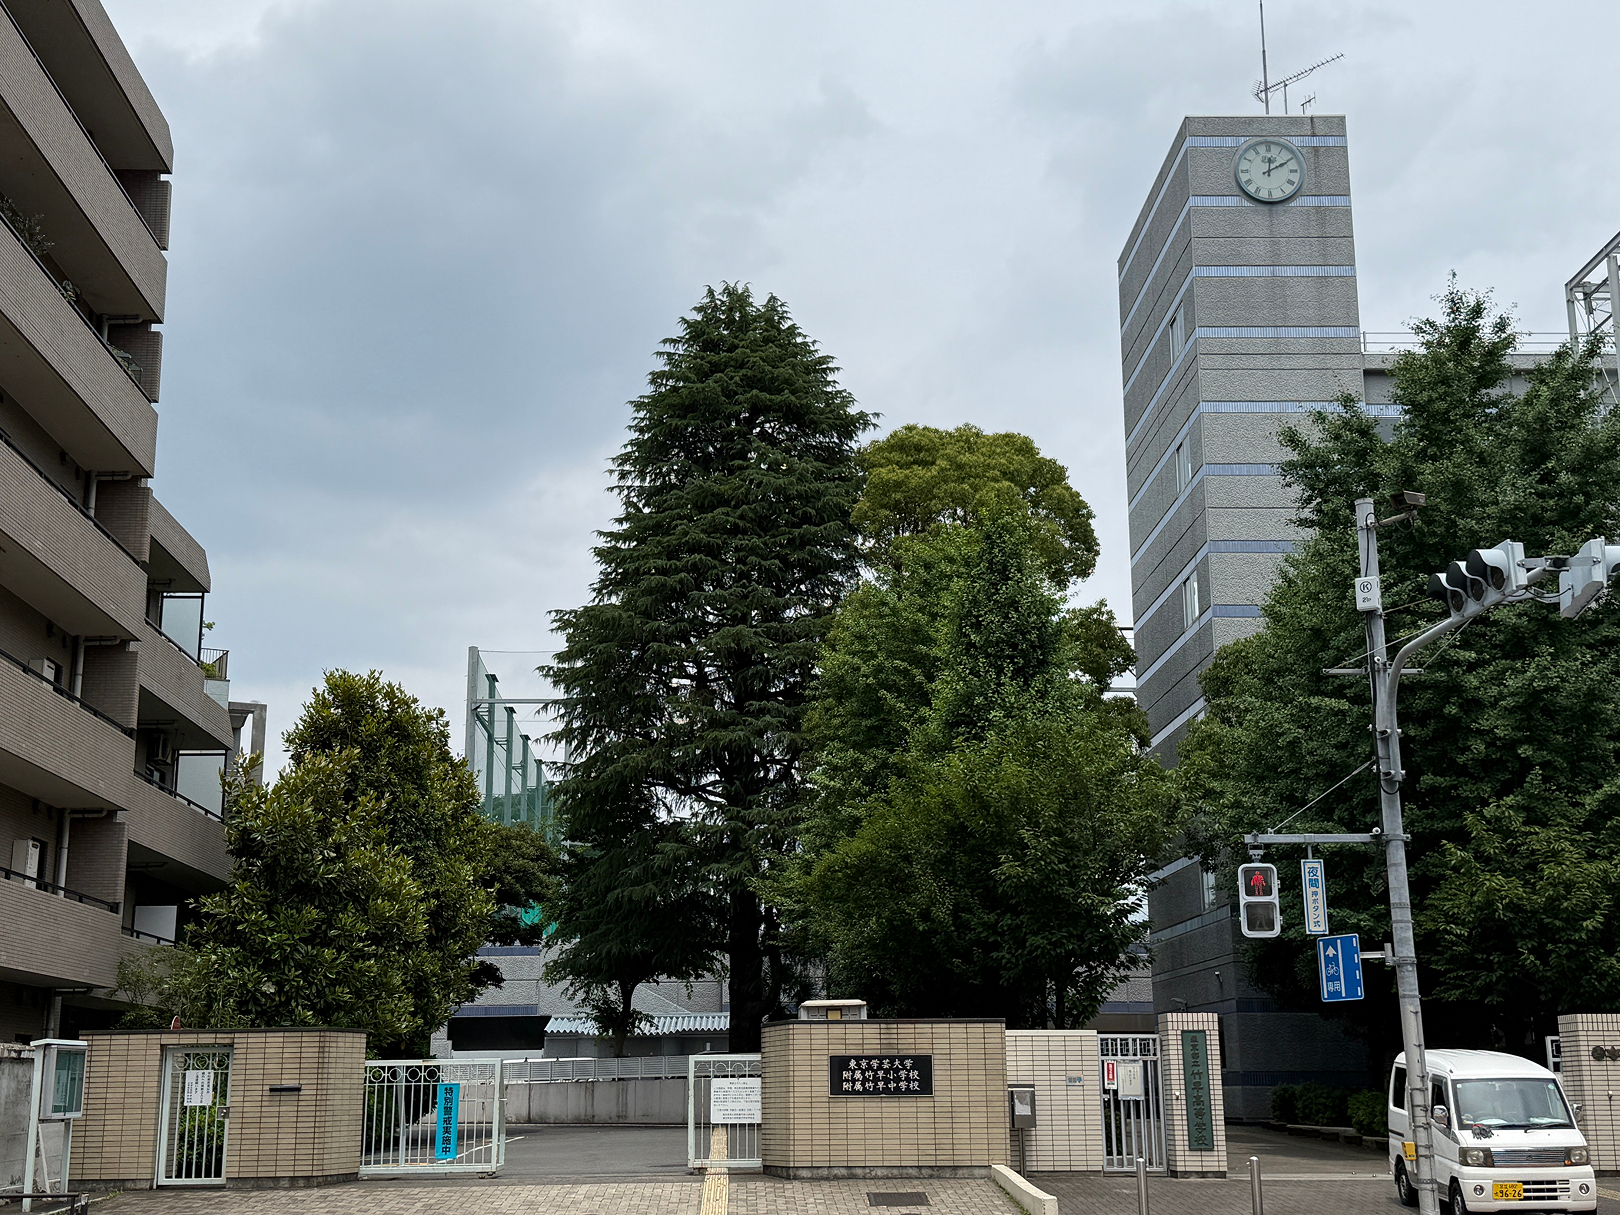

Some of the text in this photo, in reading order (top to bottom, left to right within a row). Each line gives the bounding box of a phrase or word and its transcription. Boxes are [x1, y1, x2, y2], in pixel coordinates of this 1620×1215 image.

[1327, 980, 1341, 992] 専用
[848, 1058, 914, 1070] 東京学芸大学
[842, 1070, 920, 1080] 附属竹早小学校
[842, 1081, 920, 1092] 附属竹早中学校
[441, 1086, 454, 1156] 特別警戒実施中
[1499, 1189, 1522, 1198] 96-26
